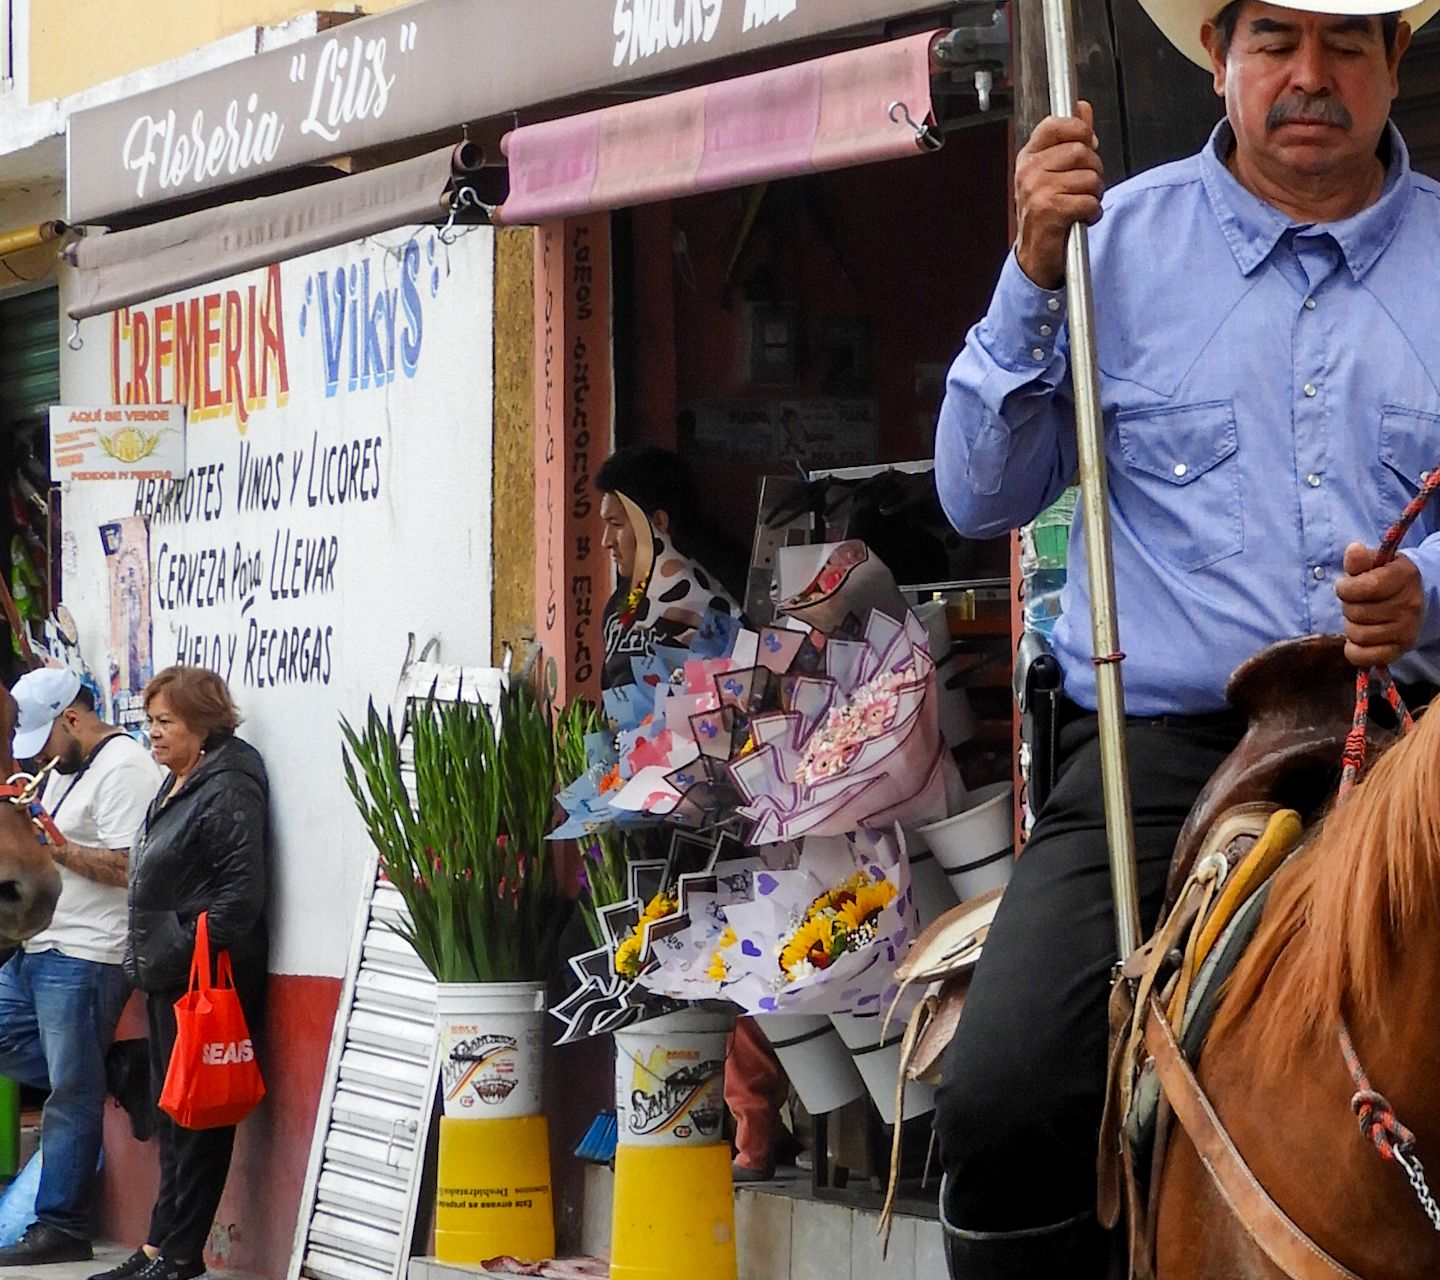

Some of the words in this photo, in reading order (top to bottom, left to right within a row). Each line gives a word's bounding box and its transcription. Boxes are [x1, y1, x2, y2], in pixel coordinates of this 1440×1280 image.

[111, 261, 289, 436] CREMERIA
[125, 409, 170, 422] VENDE
[134, 463, 224, 528] ABARROTES
[308, 430, 383, 508] LICORES
[157, 542, 227, 611] CERVEZA
[269, 528, 339, 601] LLEVAR
[243, 617, 334, 689] RECARGAS
